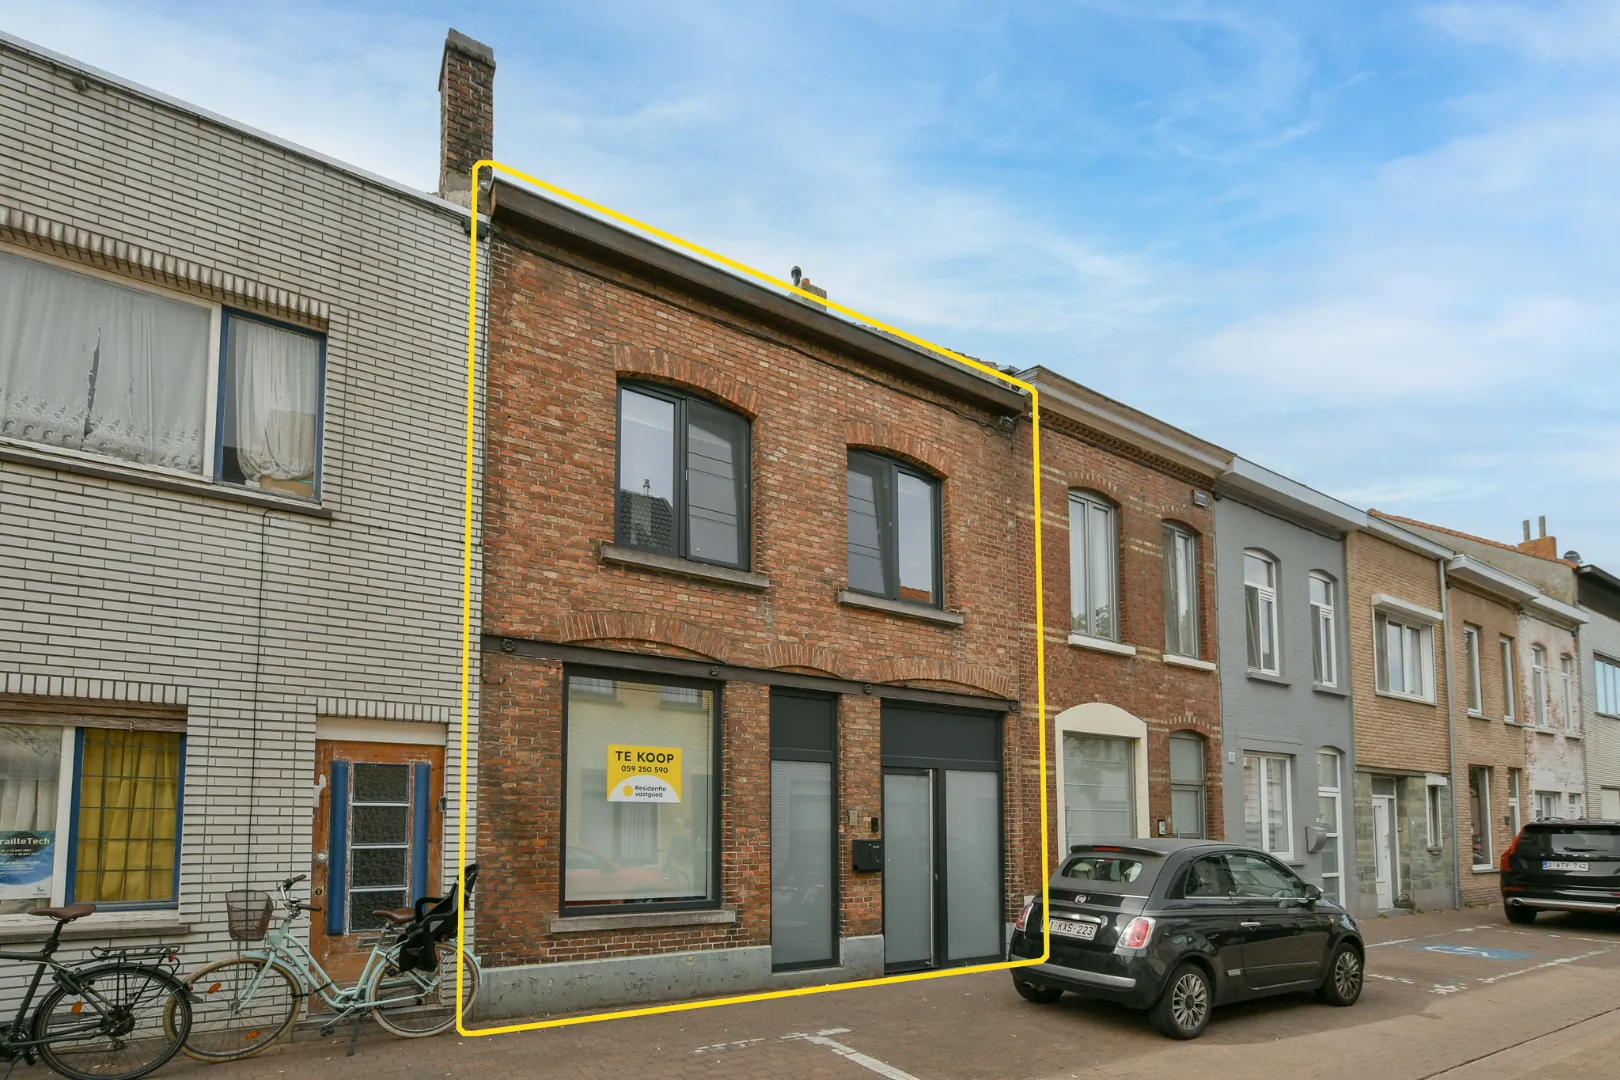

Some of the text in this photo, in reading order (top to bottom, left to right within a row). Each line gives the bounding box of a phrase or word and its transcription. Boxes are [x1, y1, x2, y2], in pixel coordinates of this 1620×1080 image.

[615, 751, 675, 764] TE KOOP
[654, 766, 669, 774] 590
